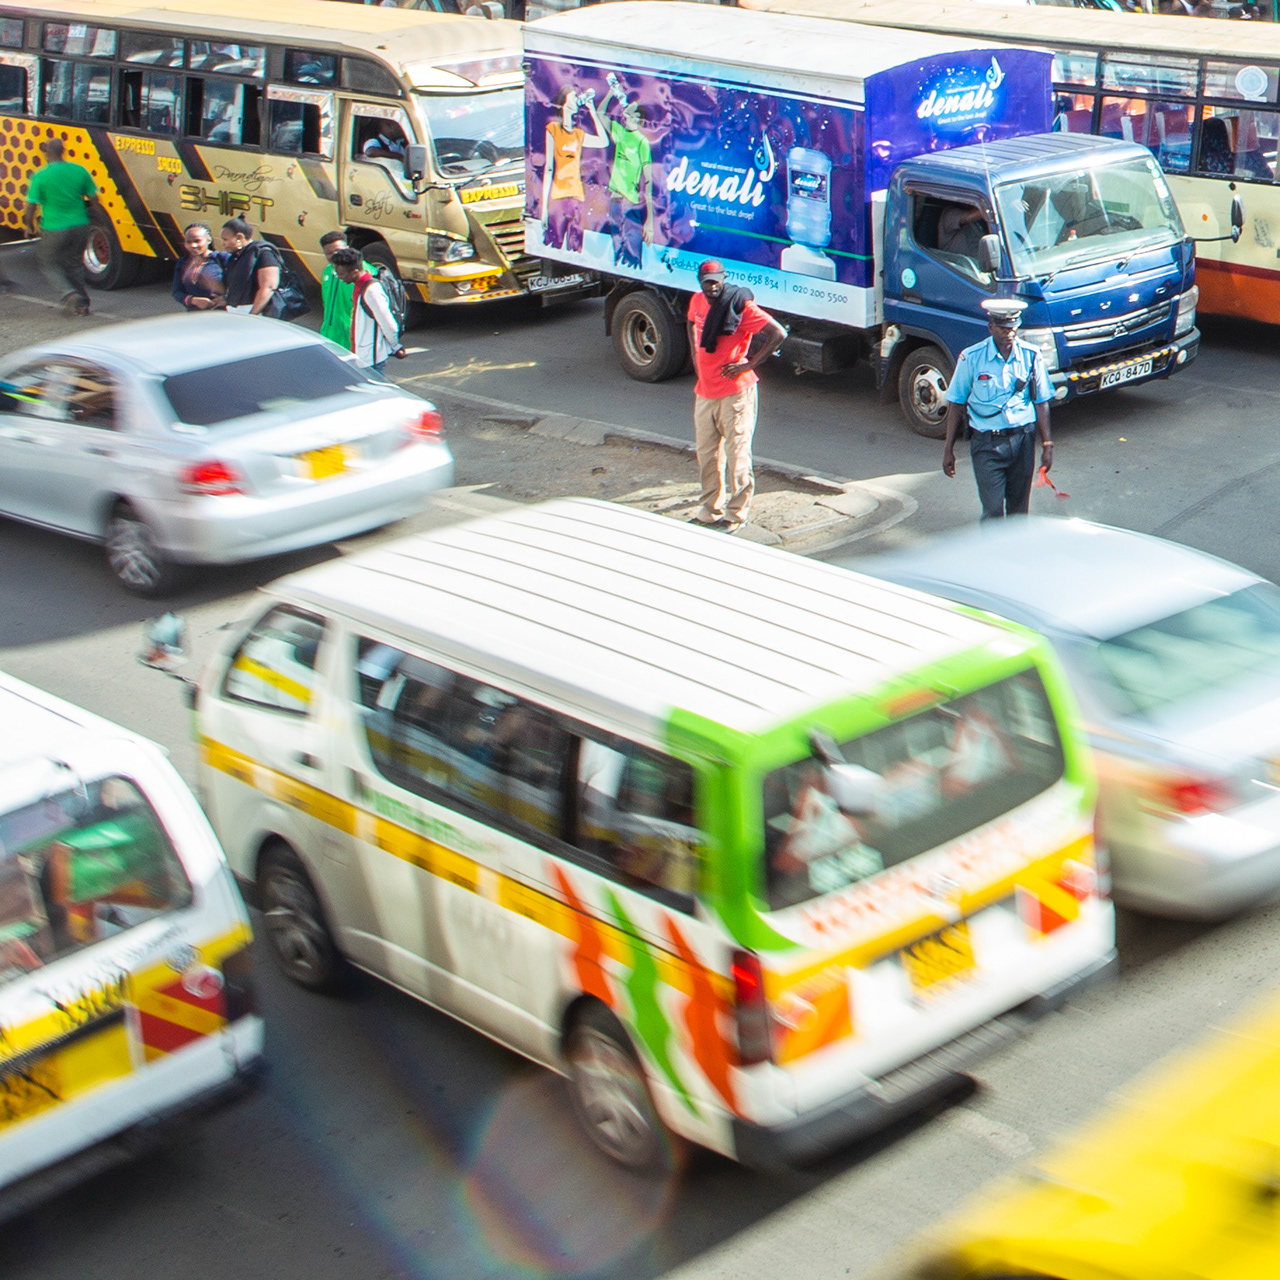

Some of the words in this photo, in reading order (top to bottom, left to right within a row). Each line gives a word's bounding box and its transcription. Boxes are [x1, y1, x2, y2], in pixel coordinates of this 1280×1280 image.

[917, 82, 994, 118] denali
[116, 136, 155, 155] EXPRESSO
[157, 156, 182, 173] SACCO
[666, 156, 766, 207] denali
[180, 185, 274, 222] SHIFT
[461, 184, 519, 204] EXPRESSO
[690, 201, 707, 211] Great
[715, 204, 726, 214] the
[726, 206, 738, 217] last
[738, 209, 754, 221] drop!
[671, 257, 700, 272] Dial-A-D
[747, 272, 763, 285] 638
[764, 275, 779, 290] 834
[792, 285, 809, 294] 020
[810, 288, 825, 299] 200
[828, 293, 848, 304] 5500
[1102, 372, 1121, 387] KCQ
[1125, 362, 1151, 379] 847D
